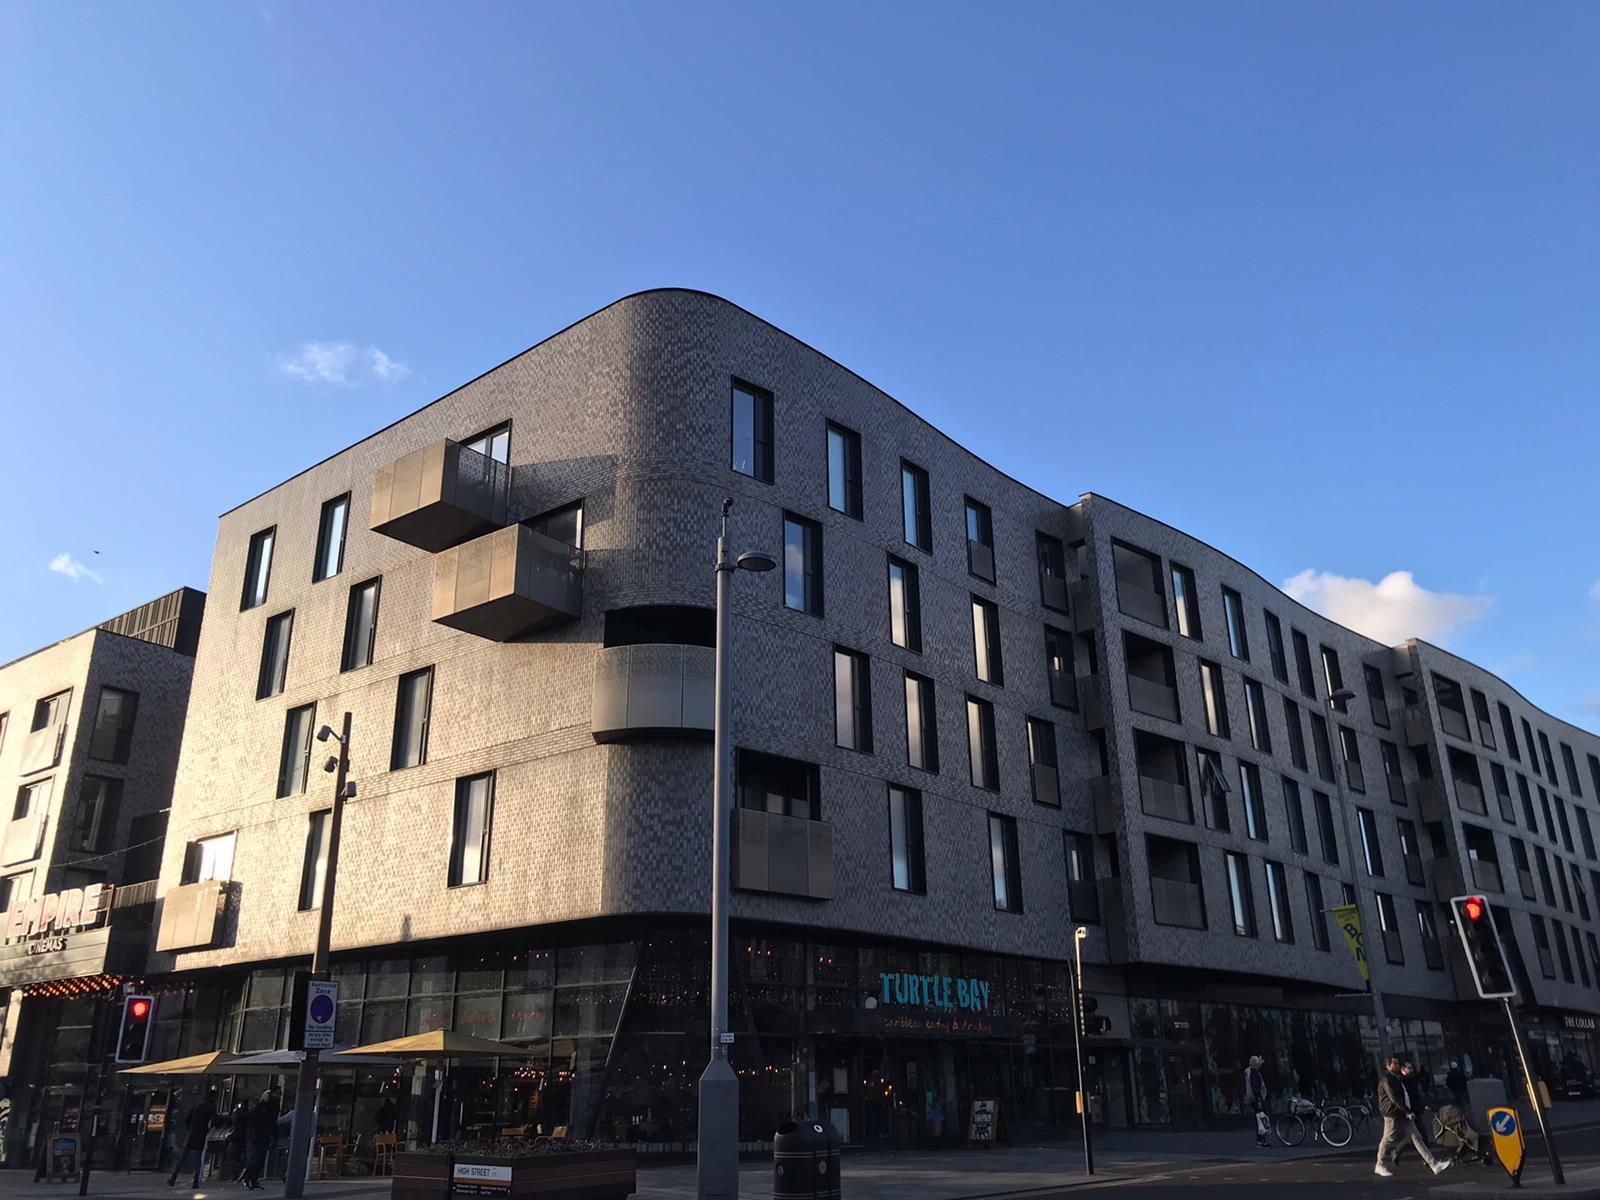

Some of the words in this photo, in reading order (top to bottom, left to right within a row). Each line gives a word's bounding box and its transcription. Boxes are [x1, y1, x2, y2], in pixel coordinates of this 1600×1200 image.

[7, 883, 103, 938] EMPIRE
[28, 938, 64, 955] CINEMAS
[880, 971, 954, 1009] TURTLE
[956, 977, 991, 1013] BAY
[471, 1168, 491, 1177] STREET
